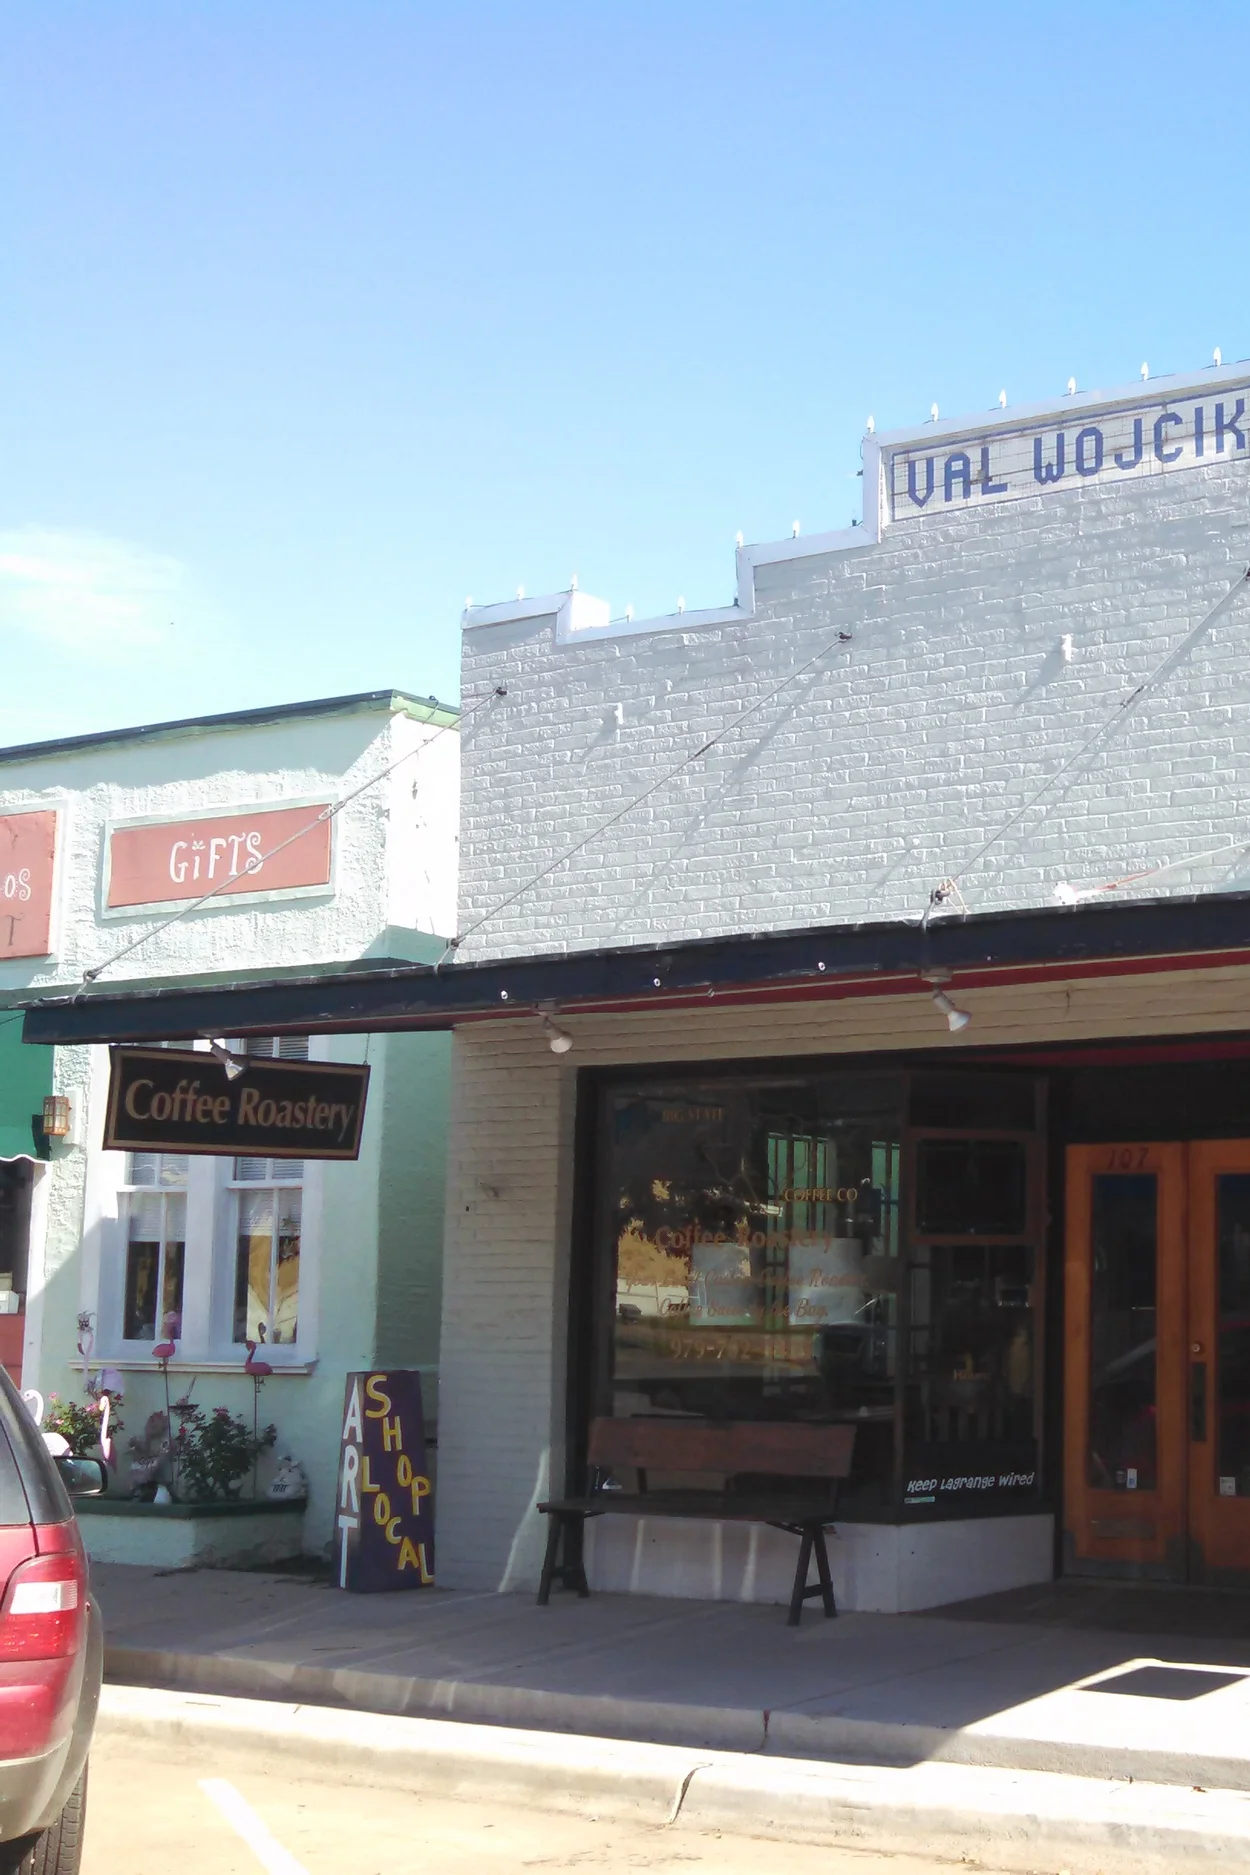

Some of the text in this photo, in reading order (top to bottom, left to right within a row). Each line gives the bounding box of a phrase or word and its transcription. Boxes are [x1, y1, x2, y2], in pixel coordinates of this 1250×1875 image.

[907, 398, 1248, 508] VAL WOJCIK
[124, 1079, 358, 1143] Coffee Roastery
[784, 1188, 833, 1202] COFFEE
[1108, 1147, 1150, 1170] 107
[655, 1224, 833, 1253] Coffee Roastery
[338, 1375, 363, 1589] ART
[364, 1374, 431, 1516] SHOP
[362, 1455, 435, 1584] LOCAL
